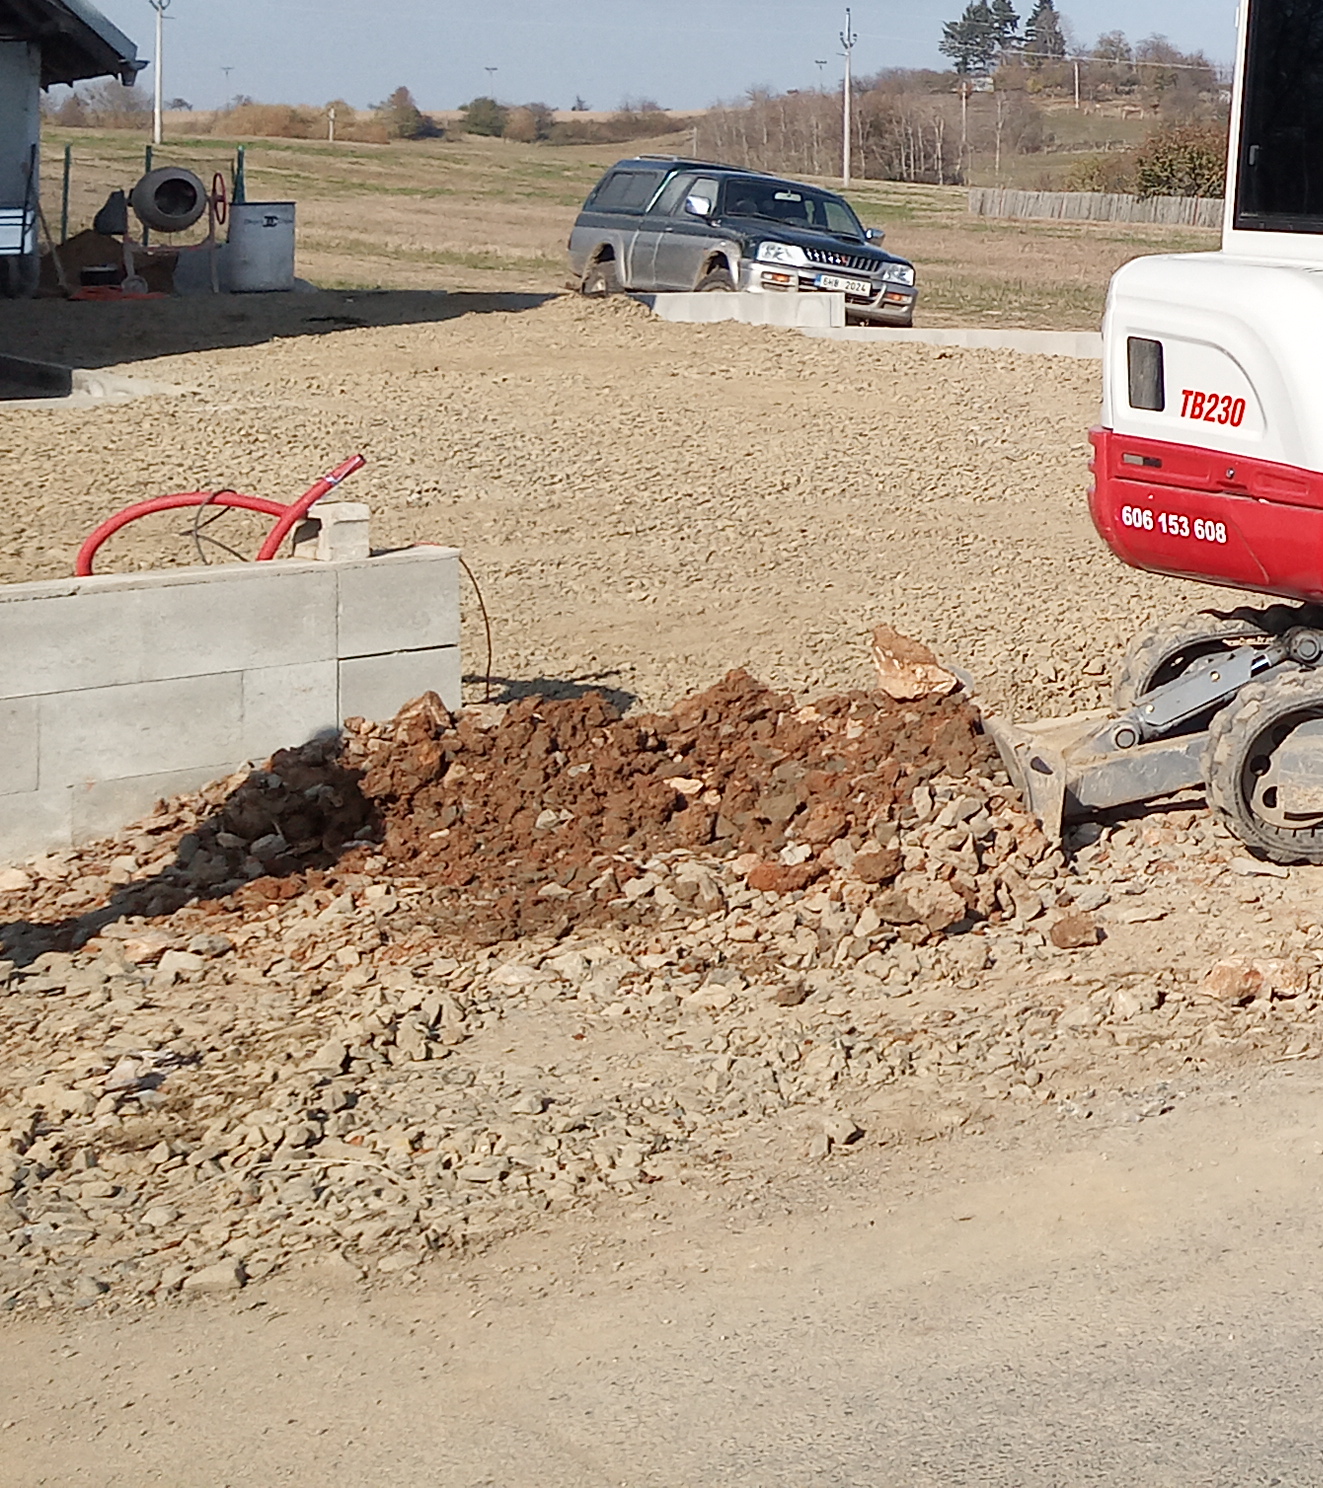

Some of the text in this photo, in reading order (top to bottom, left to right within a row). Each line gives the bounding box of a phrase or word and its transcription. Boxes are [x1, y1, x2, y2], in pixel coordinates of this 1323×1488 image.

[1180, 389, 1247, 428] TB230
[1121, 505, 1228, 544] 606 153 608
